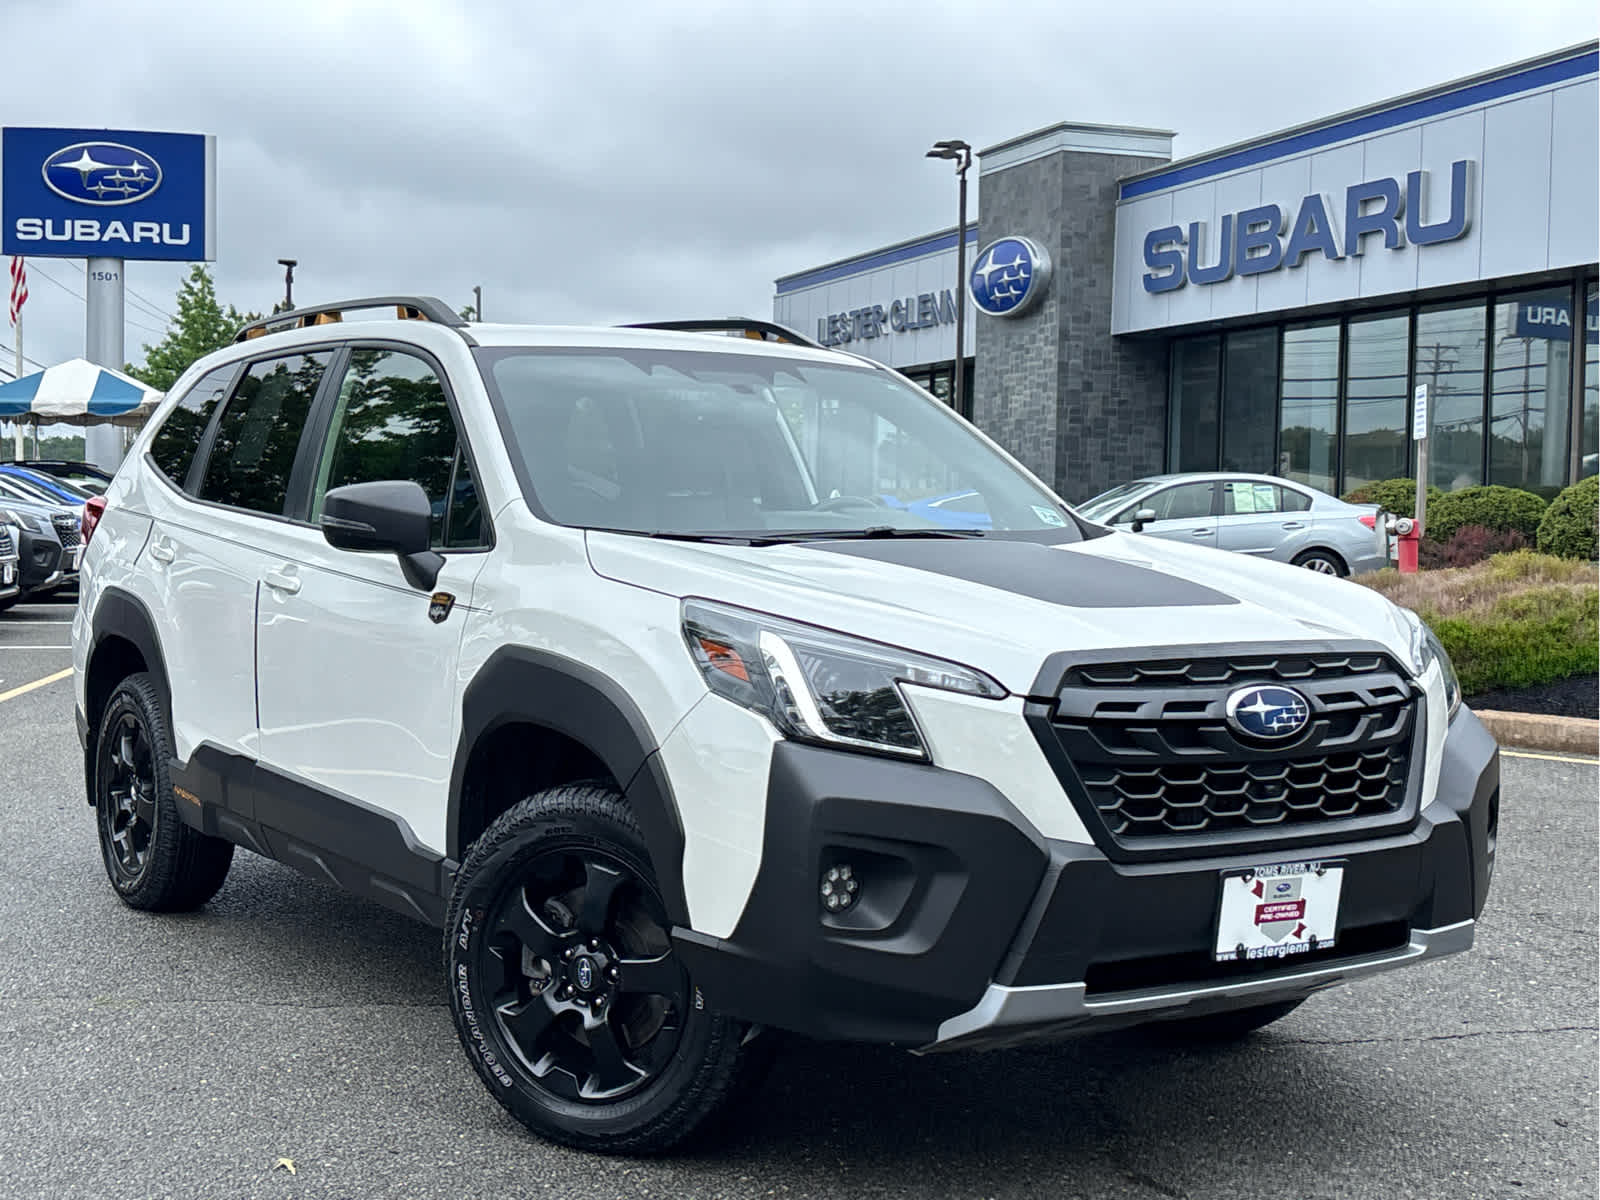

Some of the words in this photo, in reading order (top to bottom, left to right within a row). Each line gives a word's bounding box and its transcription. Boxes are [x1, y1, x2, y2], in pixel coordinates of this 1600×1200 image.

[16, 218, 190, 245] SUBARU
[1142, 159, 1474, 294] SUBARU
[91, 271, 119, 282] 1501
[818, 304, 887, 347] LESTER
[1260, 911, 1300, 921] PRE-OWNED
[1263, 904, 1298, 913] CERTIFIED
[1246, 943, 1309, 960] lesterglenn
